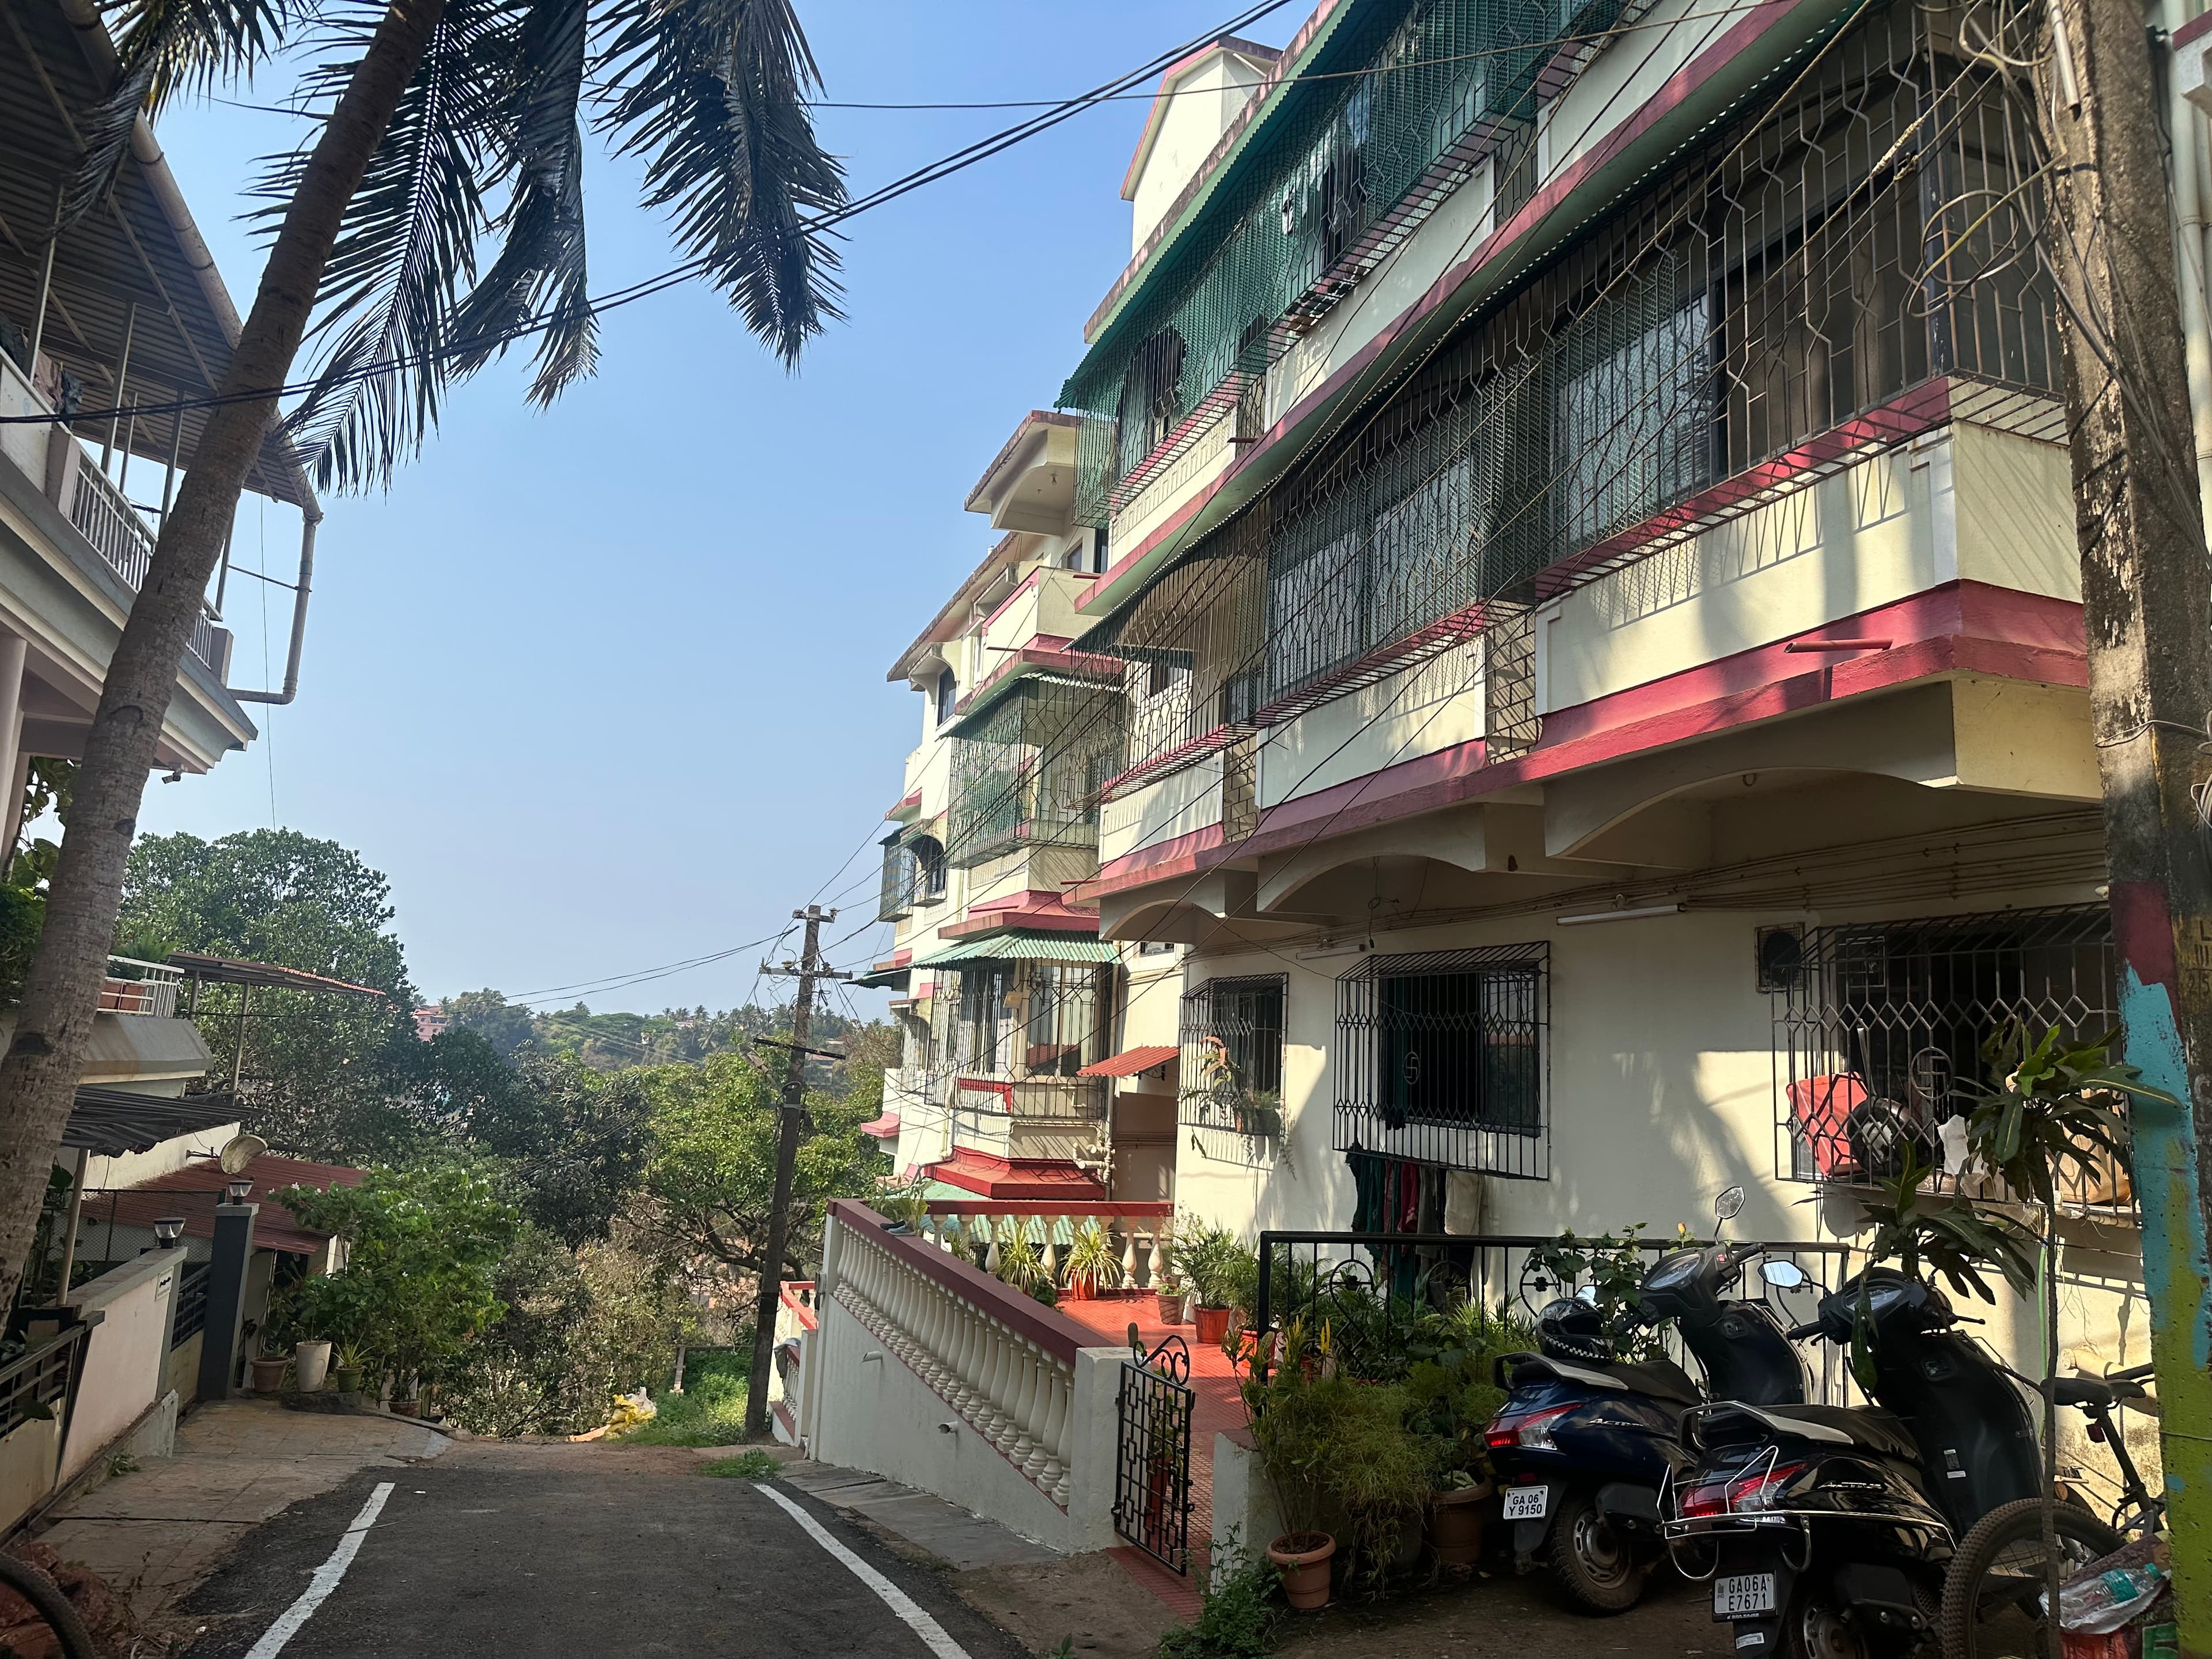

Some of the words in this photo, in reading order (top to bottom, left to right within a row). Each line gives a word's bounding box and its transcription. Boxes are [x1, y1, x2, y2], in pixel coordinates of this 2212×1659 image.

[1513, 1496, 1525, 1505] GA
[1528, 1494, 1539, 1503] 06
[1509, 1506, 1516, 1516] Y
[1518, 1504, 1542, 1515] 9150
[1729, 1575, 1767, 1593] GA06A
[1729, 1592, 1766, 1611] E7671
